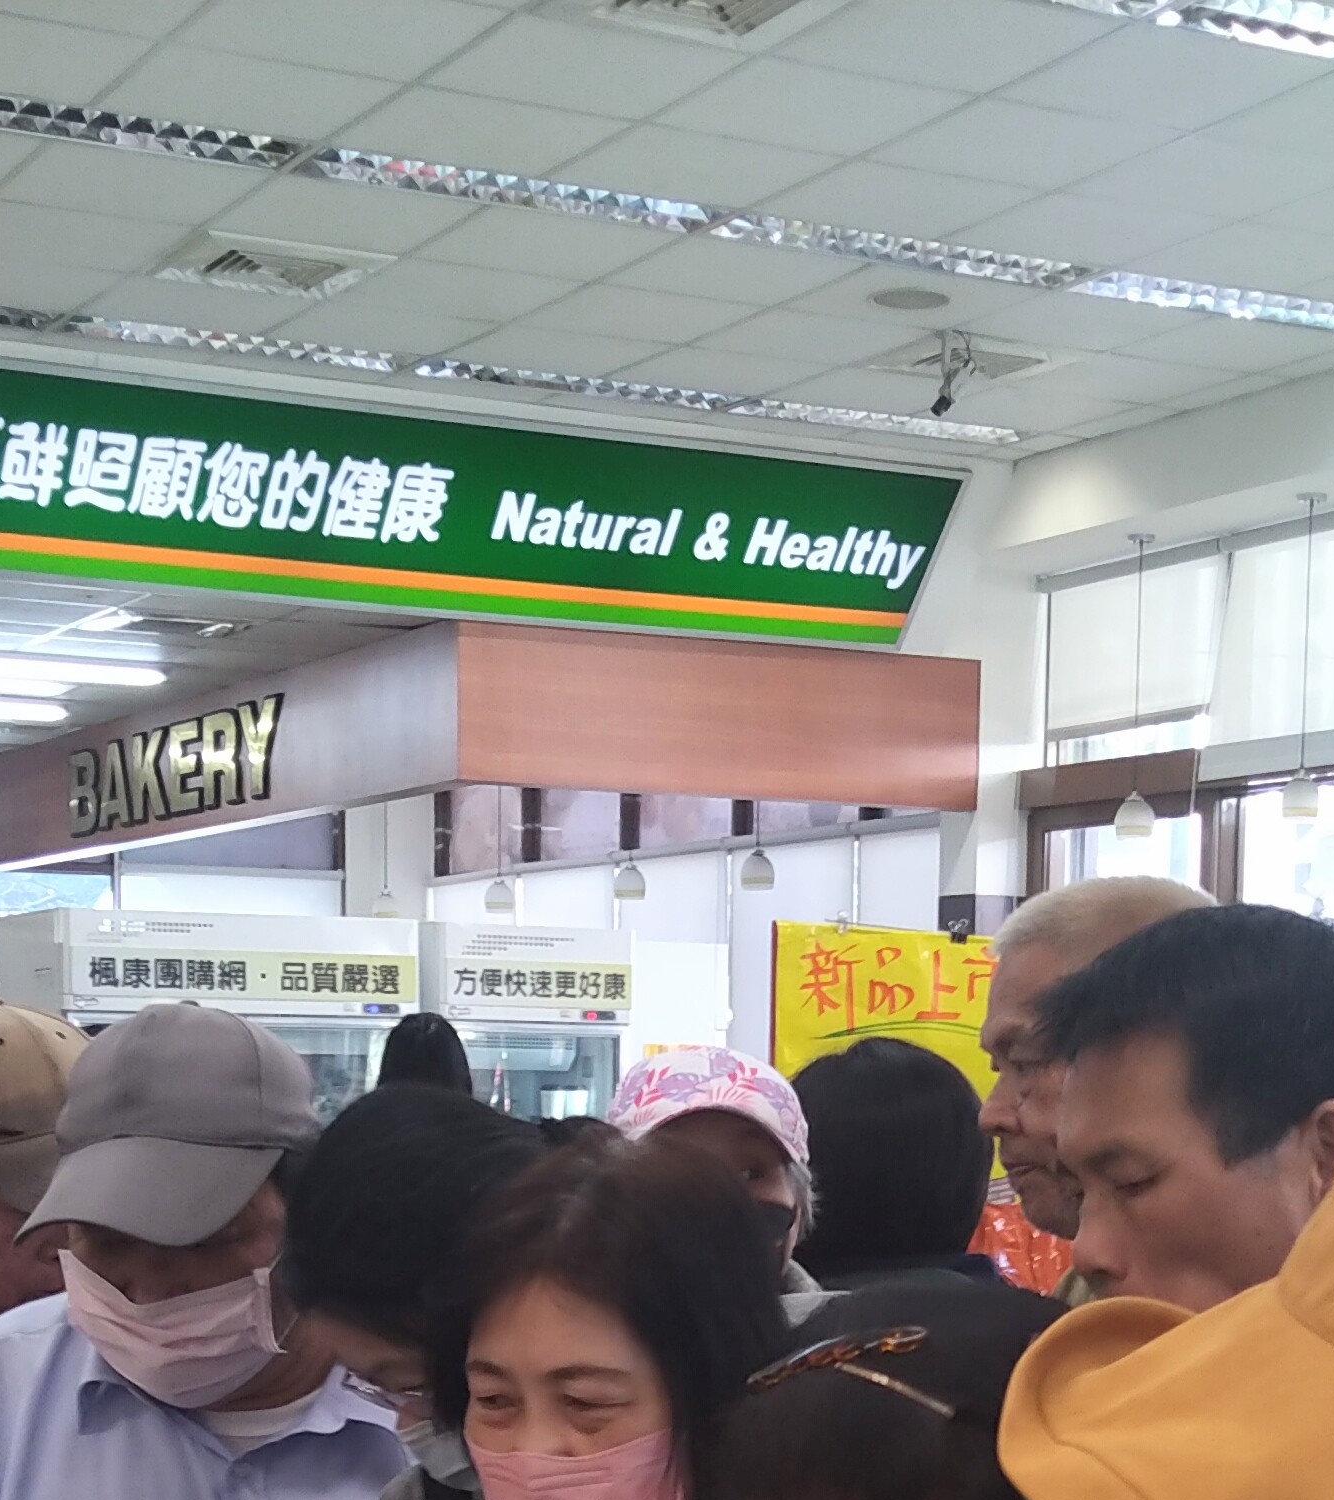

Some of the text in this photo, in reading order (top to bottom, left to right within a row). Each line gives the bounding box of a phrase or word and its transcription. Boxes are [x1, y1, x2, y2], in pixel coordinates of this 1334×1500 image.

[490, 490, 927, 590] Natural & Healthy
[68, 692, 285, 840] BAKERY
[452, 967, 628, 1001] 方便快速更好康
